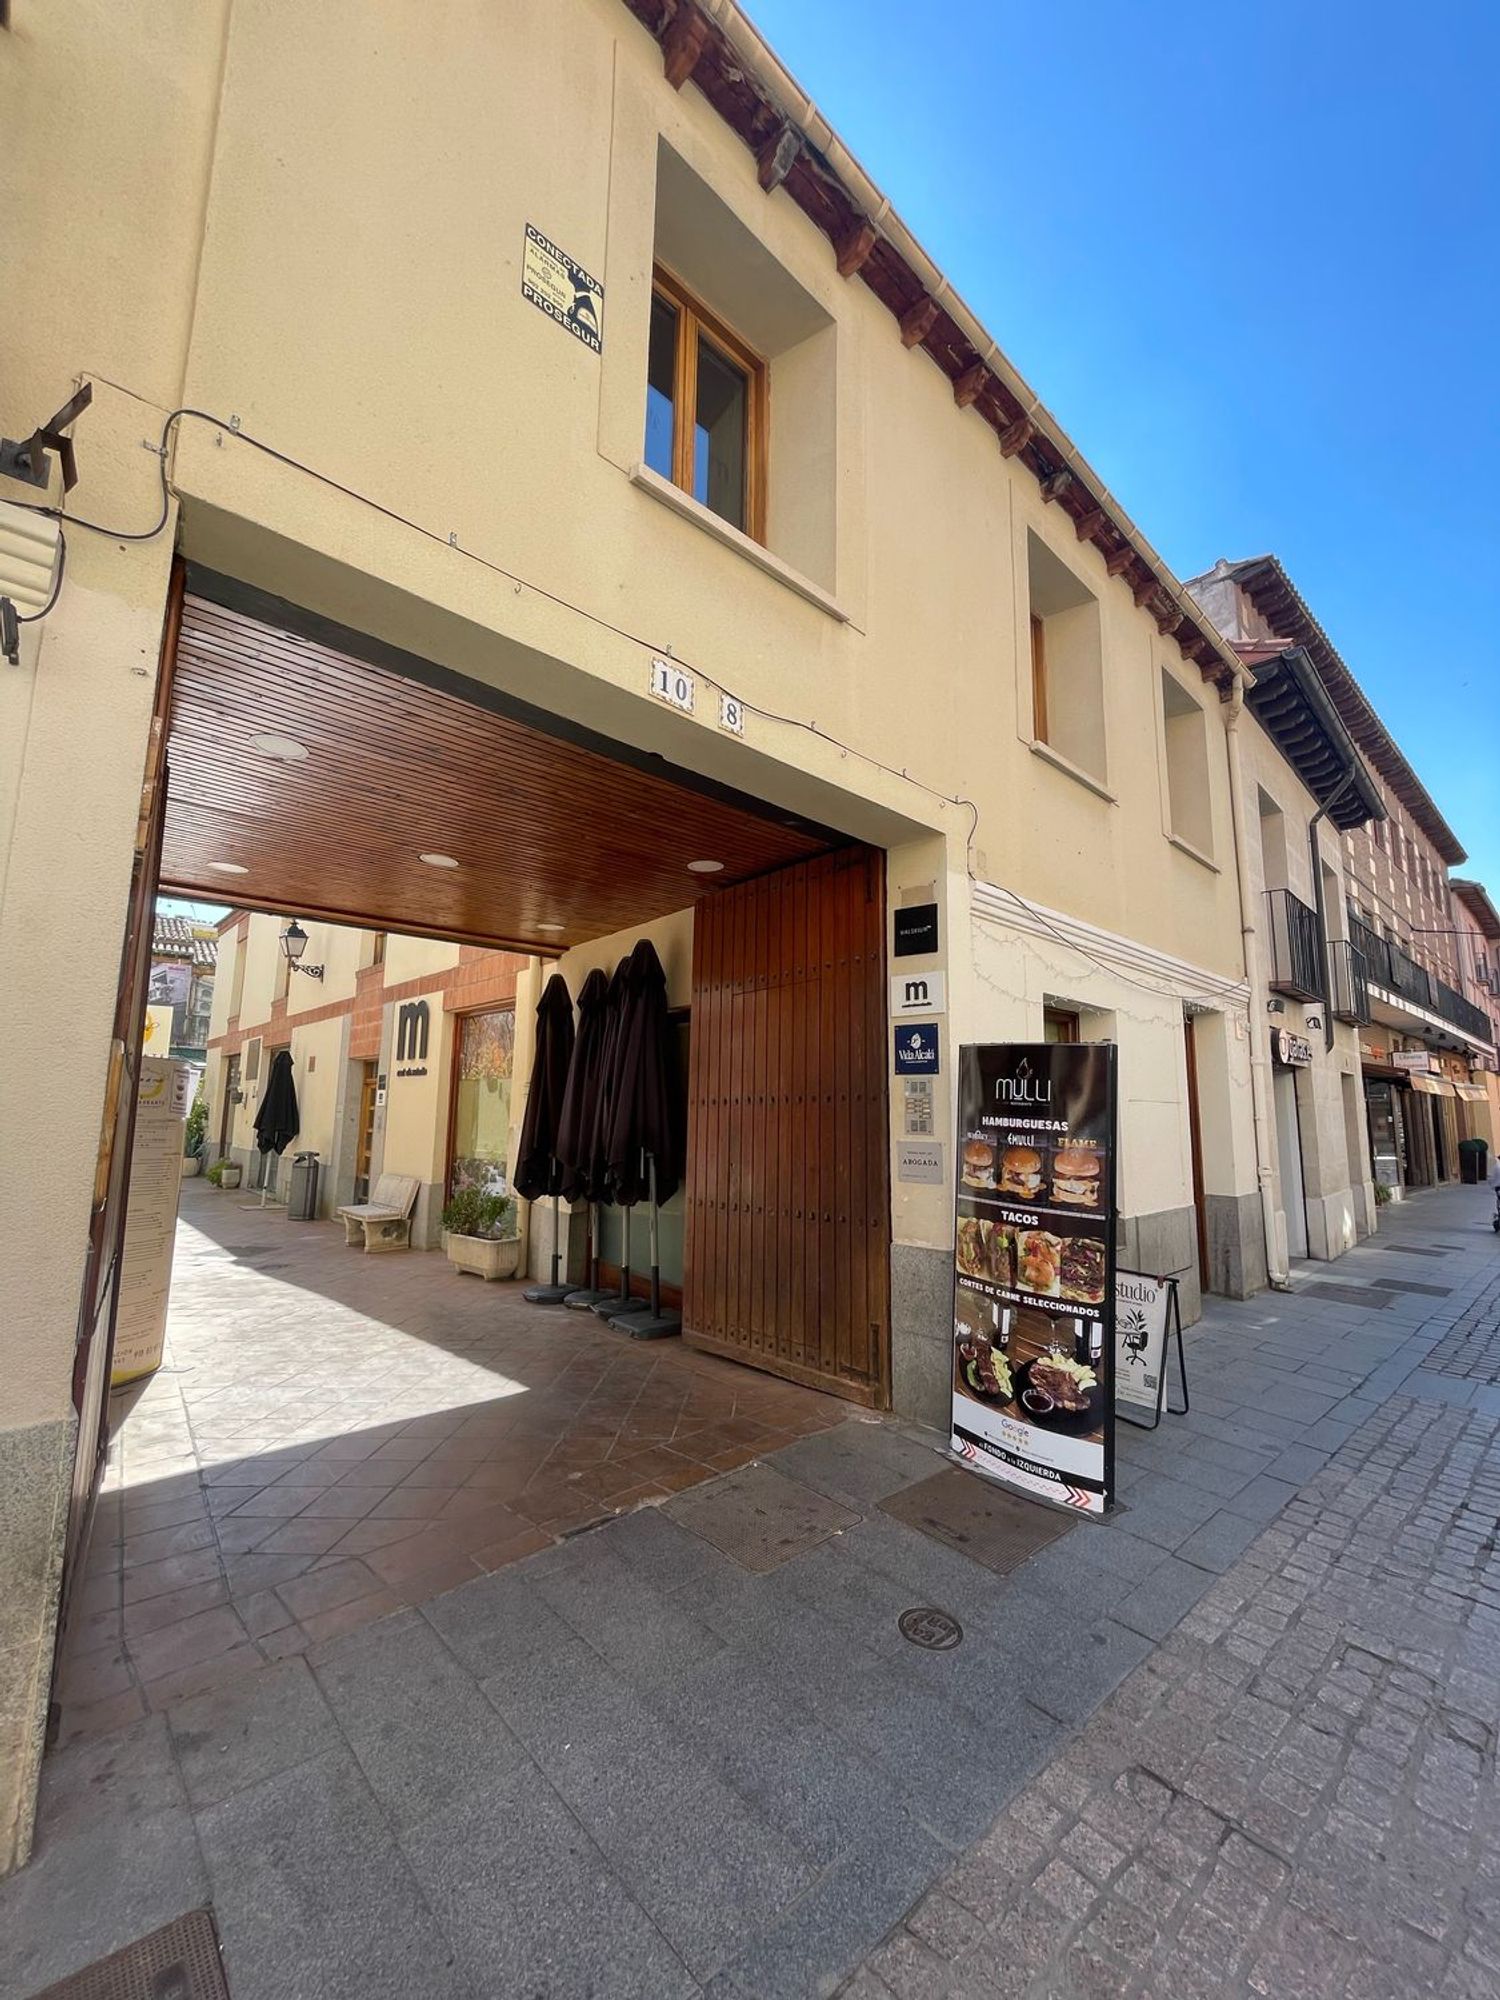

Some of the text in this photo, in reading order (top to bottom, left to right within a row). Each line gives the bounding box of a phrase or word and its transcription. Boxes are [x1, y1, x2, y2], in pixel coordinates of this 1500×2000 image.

[527, 226, 603, 297] CONECTADA
[526, 264, 566, 298] PROSEGUR
[523, 287, 600, 351] PROSEGUR
[660, 671, 687, 700] 10
[726, 703, 737, 725] 8
[905, 980, 928, 1001] m
[396, 999, 430, 1061] m
[898, 1049, 914, 1060] Vida
[982, 1116, 1069, 1131] HAMBURGUESAS
[1057, 1137, 1097, 1149] FLAME
[902, 1158, 939, 1167] ABOGADA
[1001, 1210, 1039, 1226] TACOS
[959, 1277, 1100, 1318] CORTES DE CARNE SELECCIONADOS
[1001, 1418, 1030, 1438] Google
[983, 1444, 1007, 1460] FONDO
[1016, 1459, 1062, 1481] IZQUIERDA
